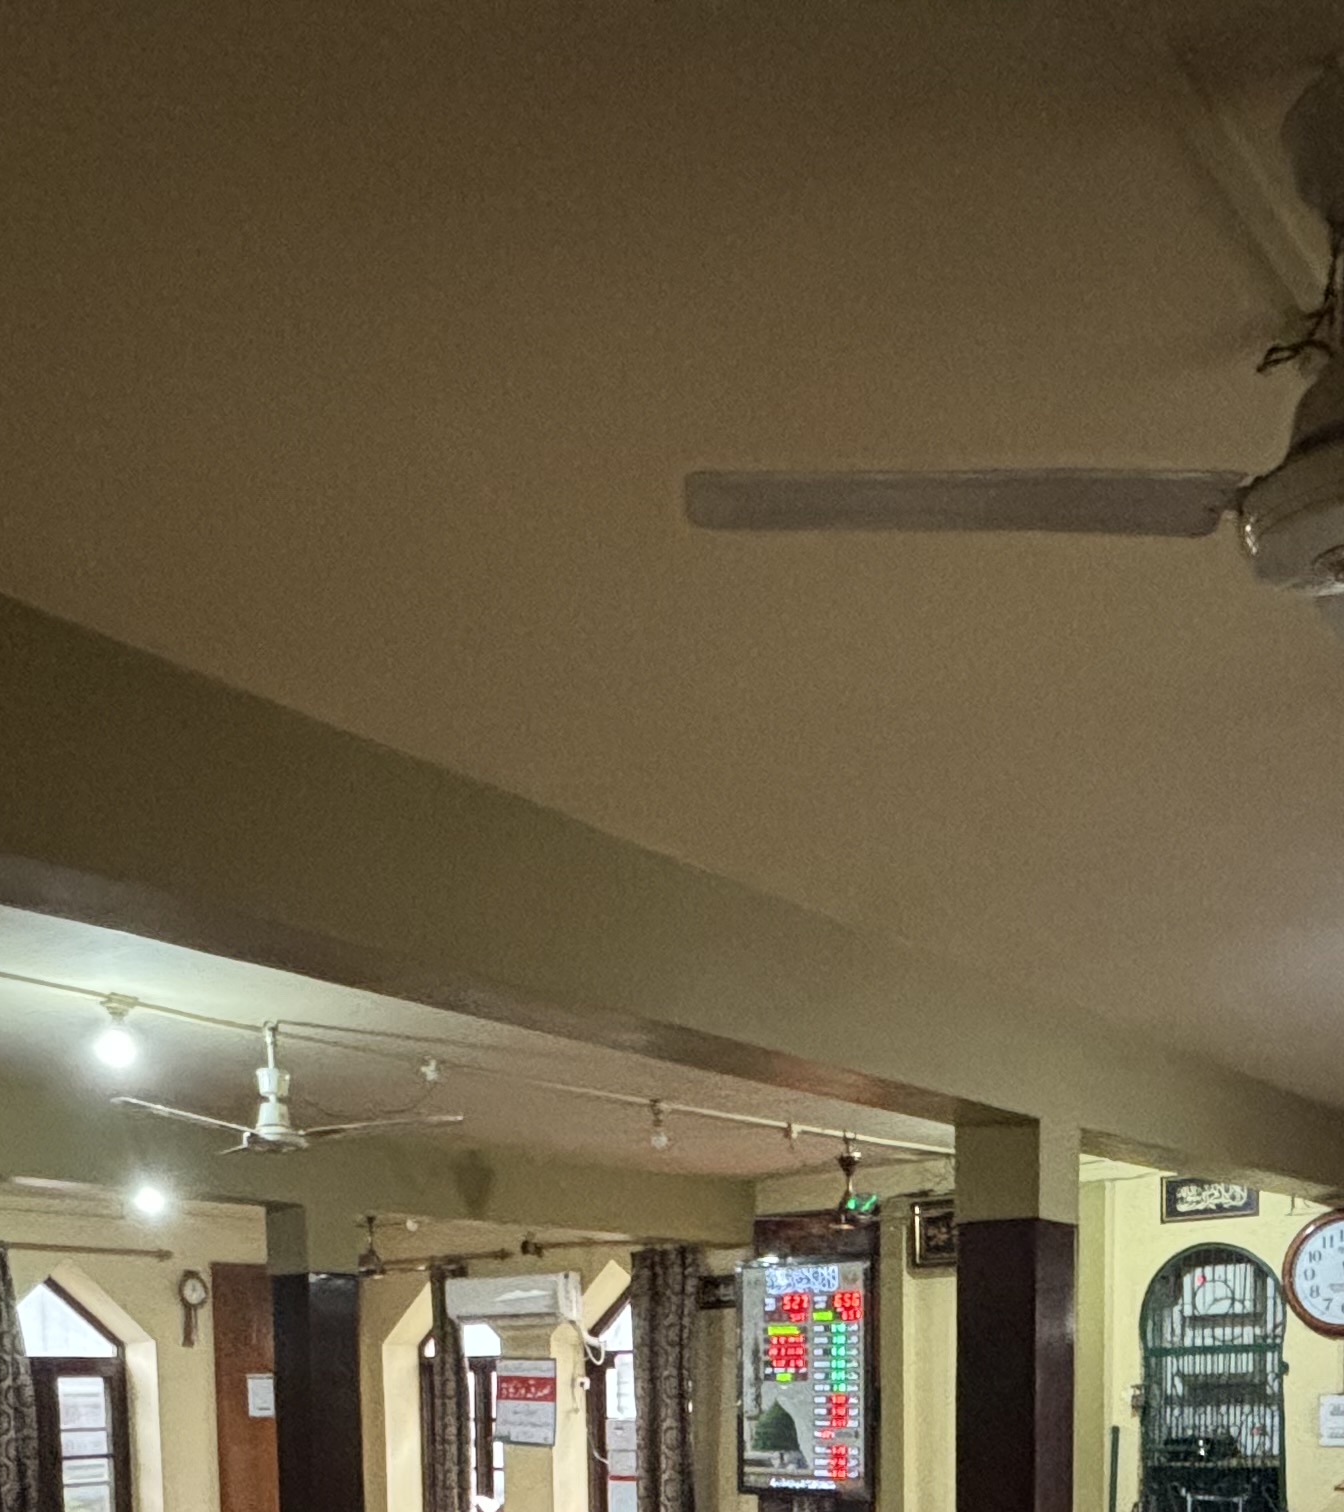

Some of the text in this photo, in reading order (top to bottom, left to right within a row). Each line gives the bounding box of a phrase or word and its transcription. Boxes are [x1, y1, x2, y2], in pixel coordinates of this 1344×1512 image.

[1322, 1235, 1334, 1249] 11
[1308, 1250, 1322, 1263] 10
[1303, 1267, 1316, 1281] 9
[1309, 1285, 1320, 1298] 8
[1322, 1298, 1334, 1312] 7
